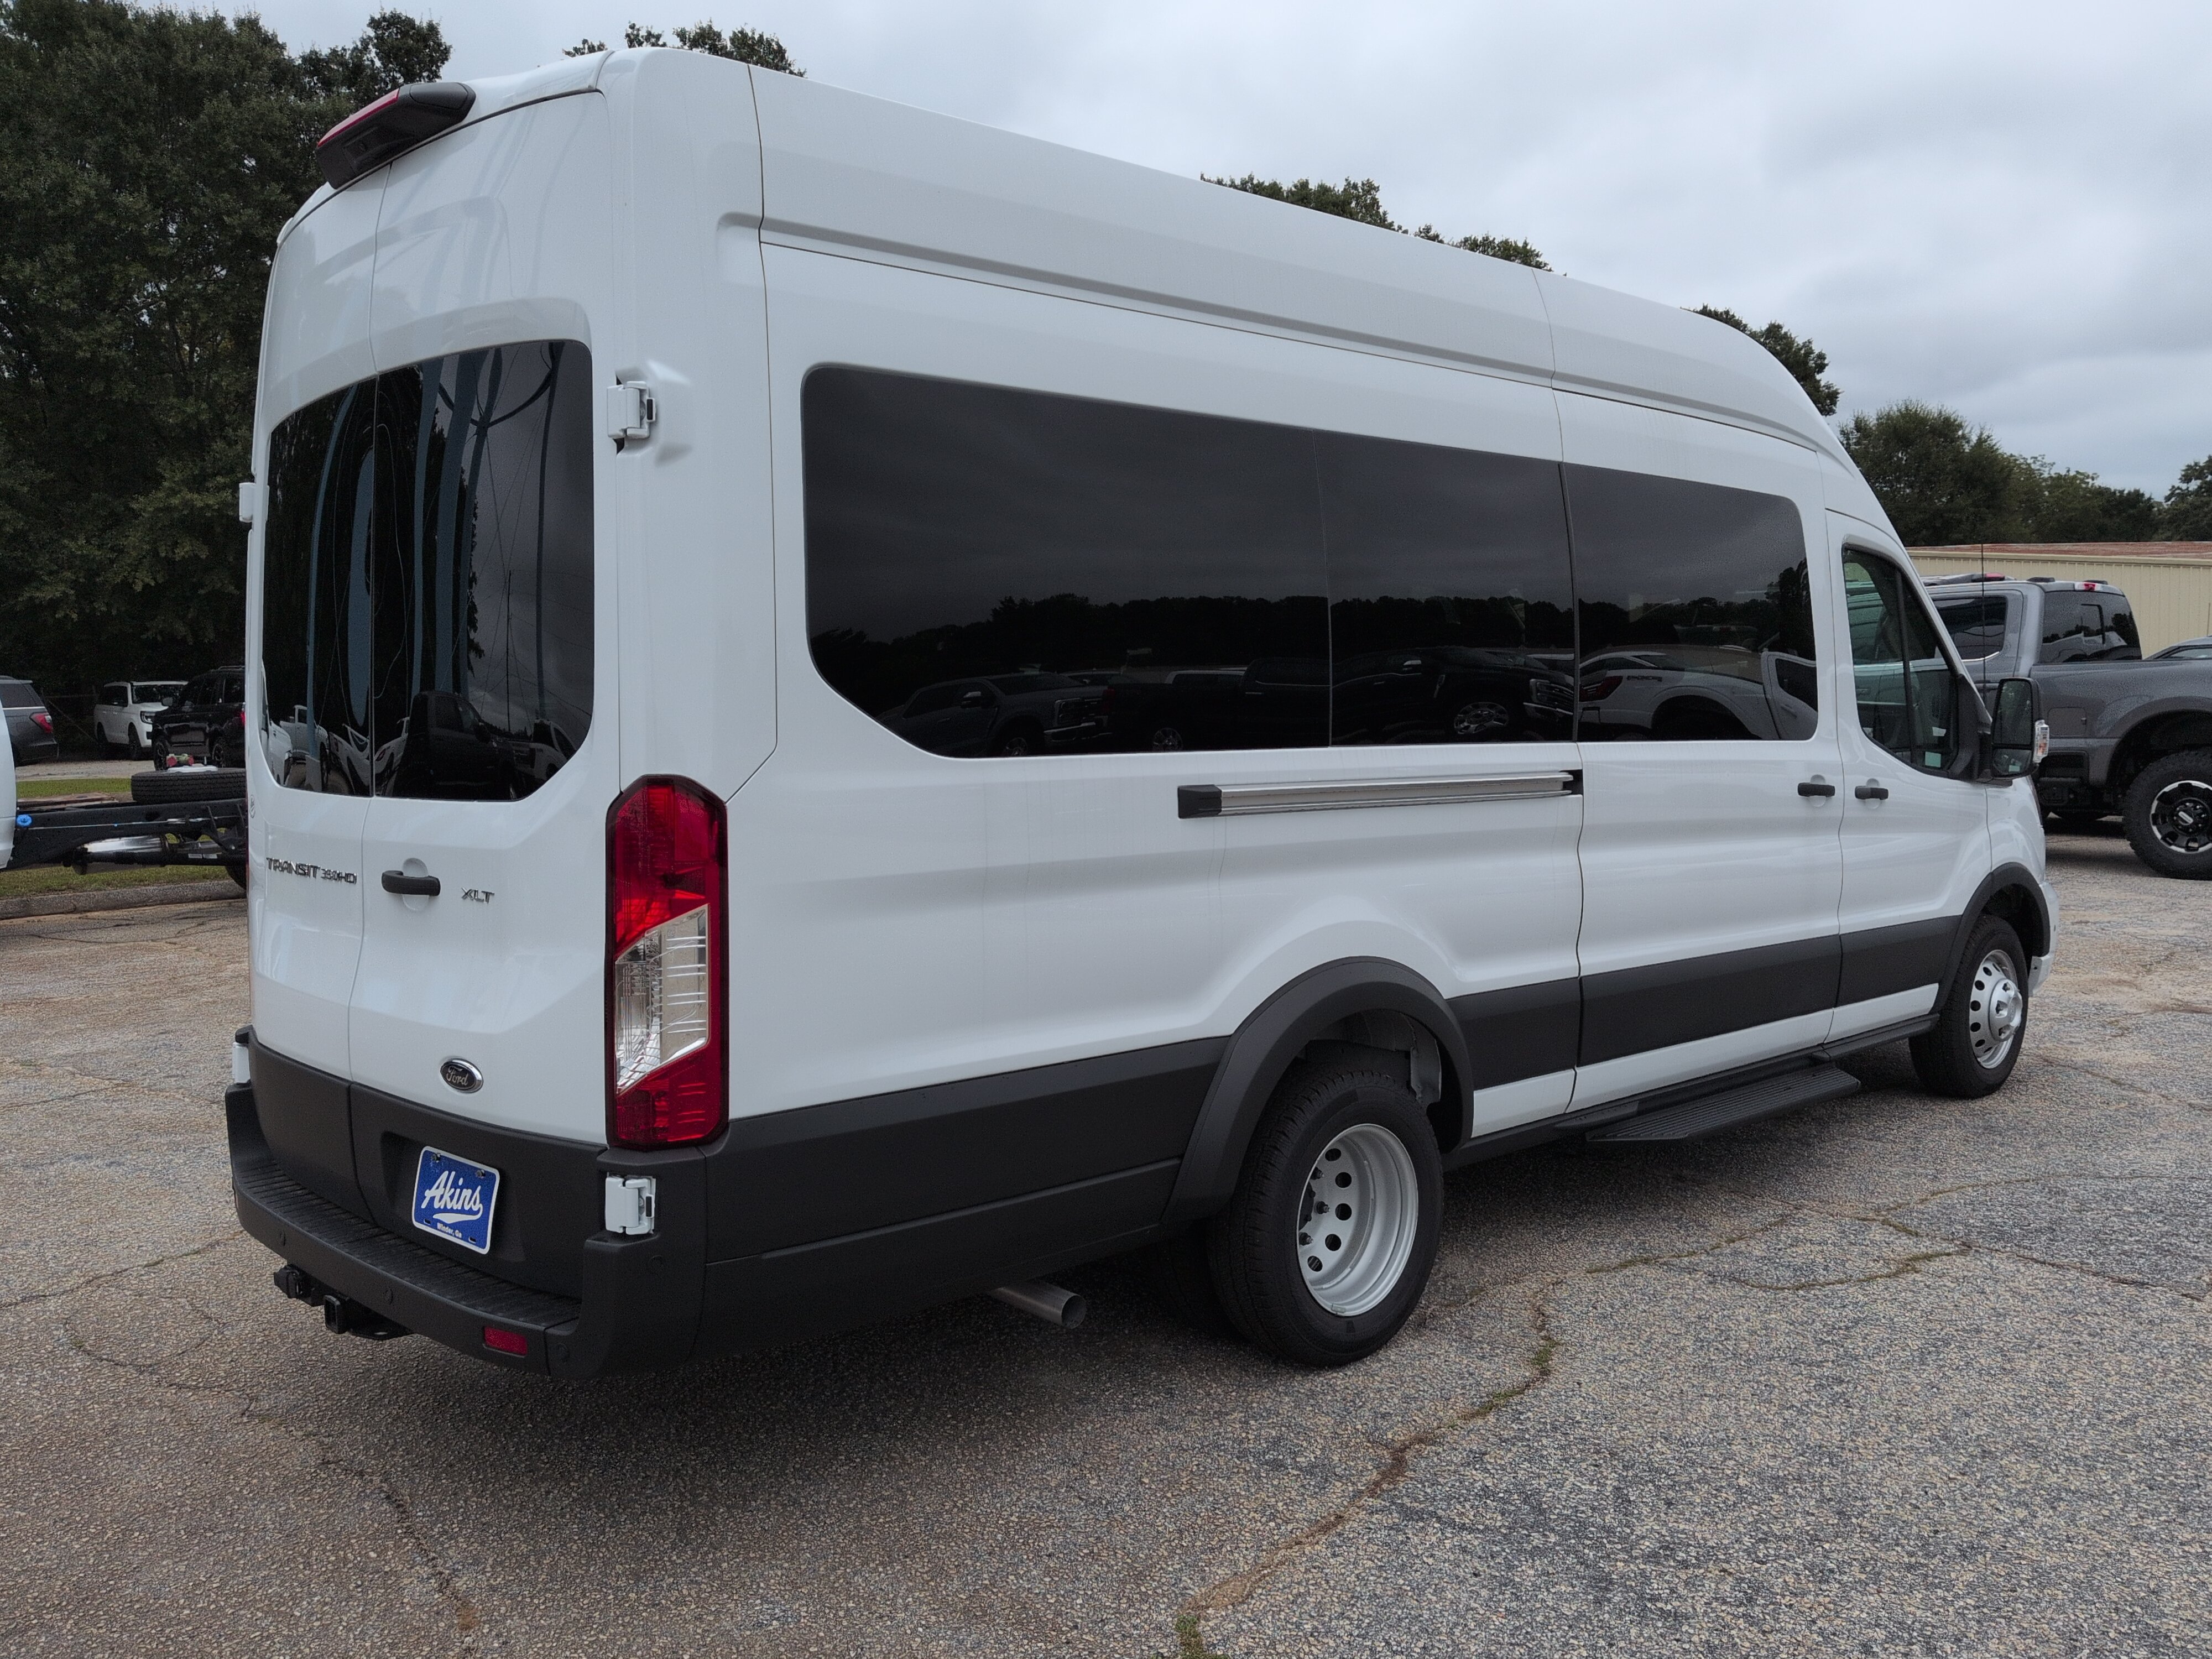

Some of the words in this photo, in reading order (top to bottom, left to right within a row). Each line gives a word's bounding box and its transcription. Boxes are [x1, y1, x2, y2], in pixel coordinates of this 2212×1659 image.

[266, 857, 321, 878] TRANSIT
[461, 887, 495, 904] XLT
[446, 1066, 468, 1086] Ford
[421, 1170, 483, 1212] Akins
